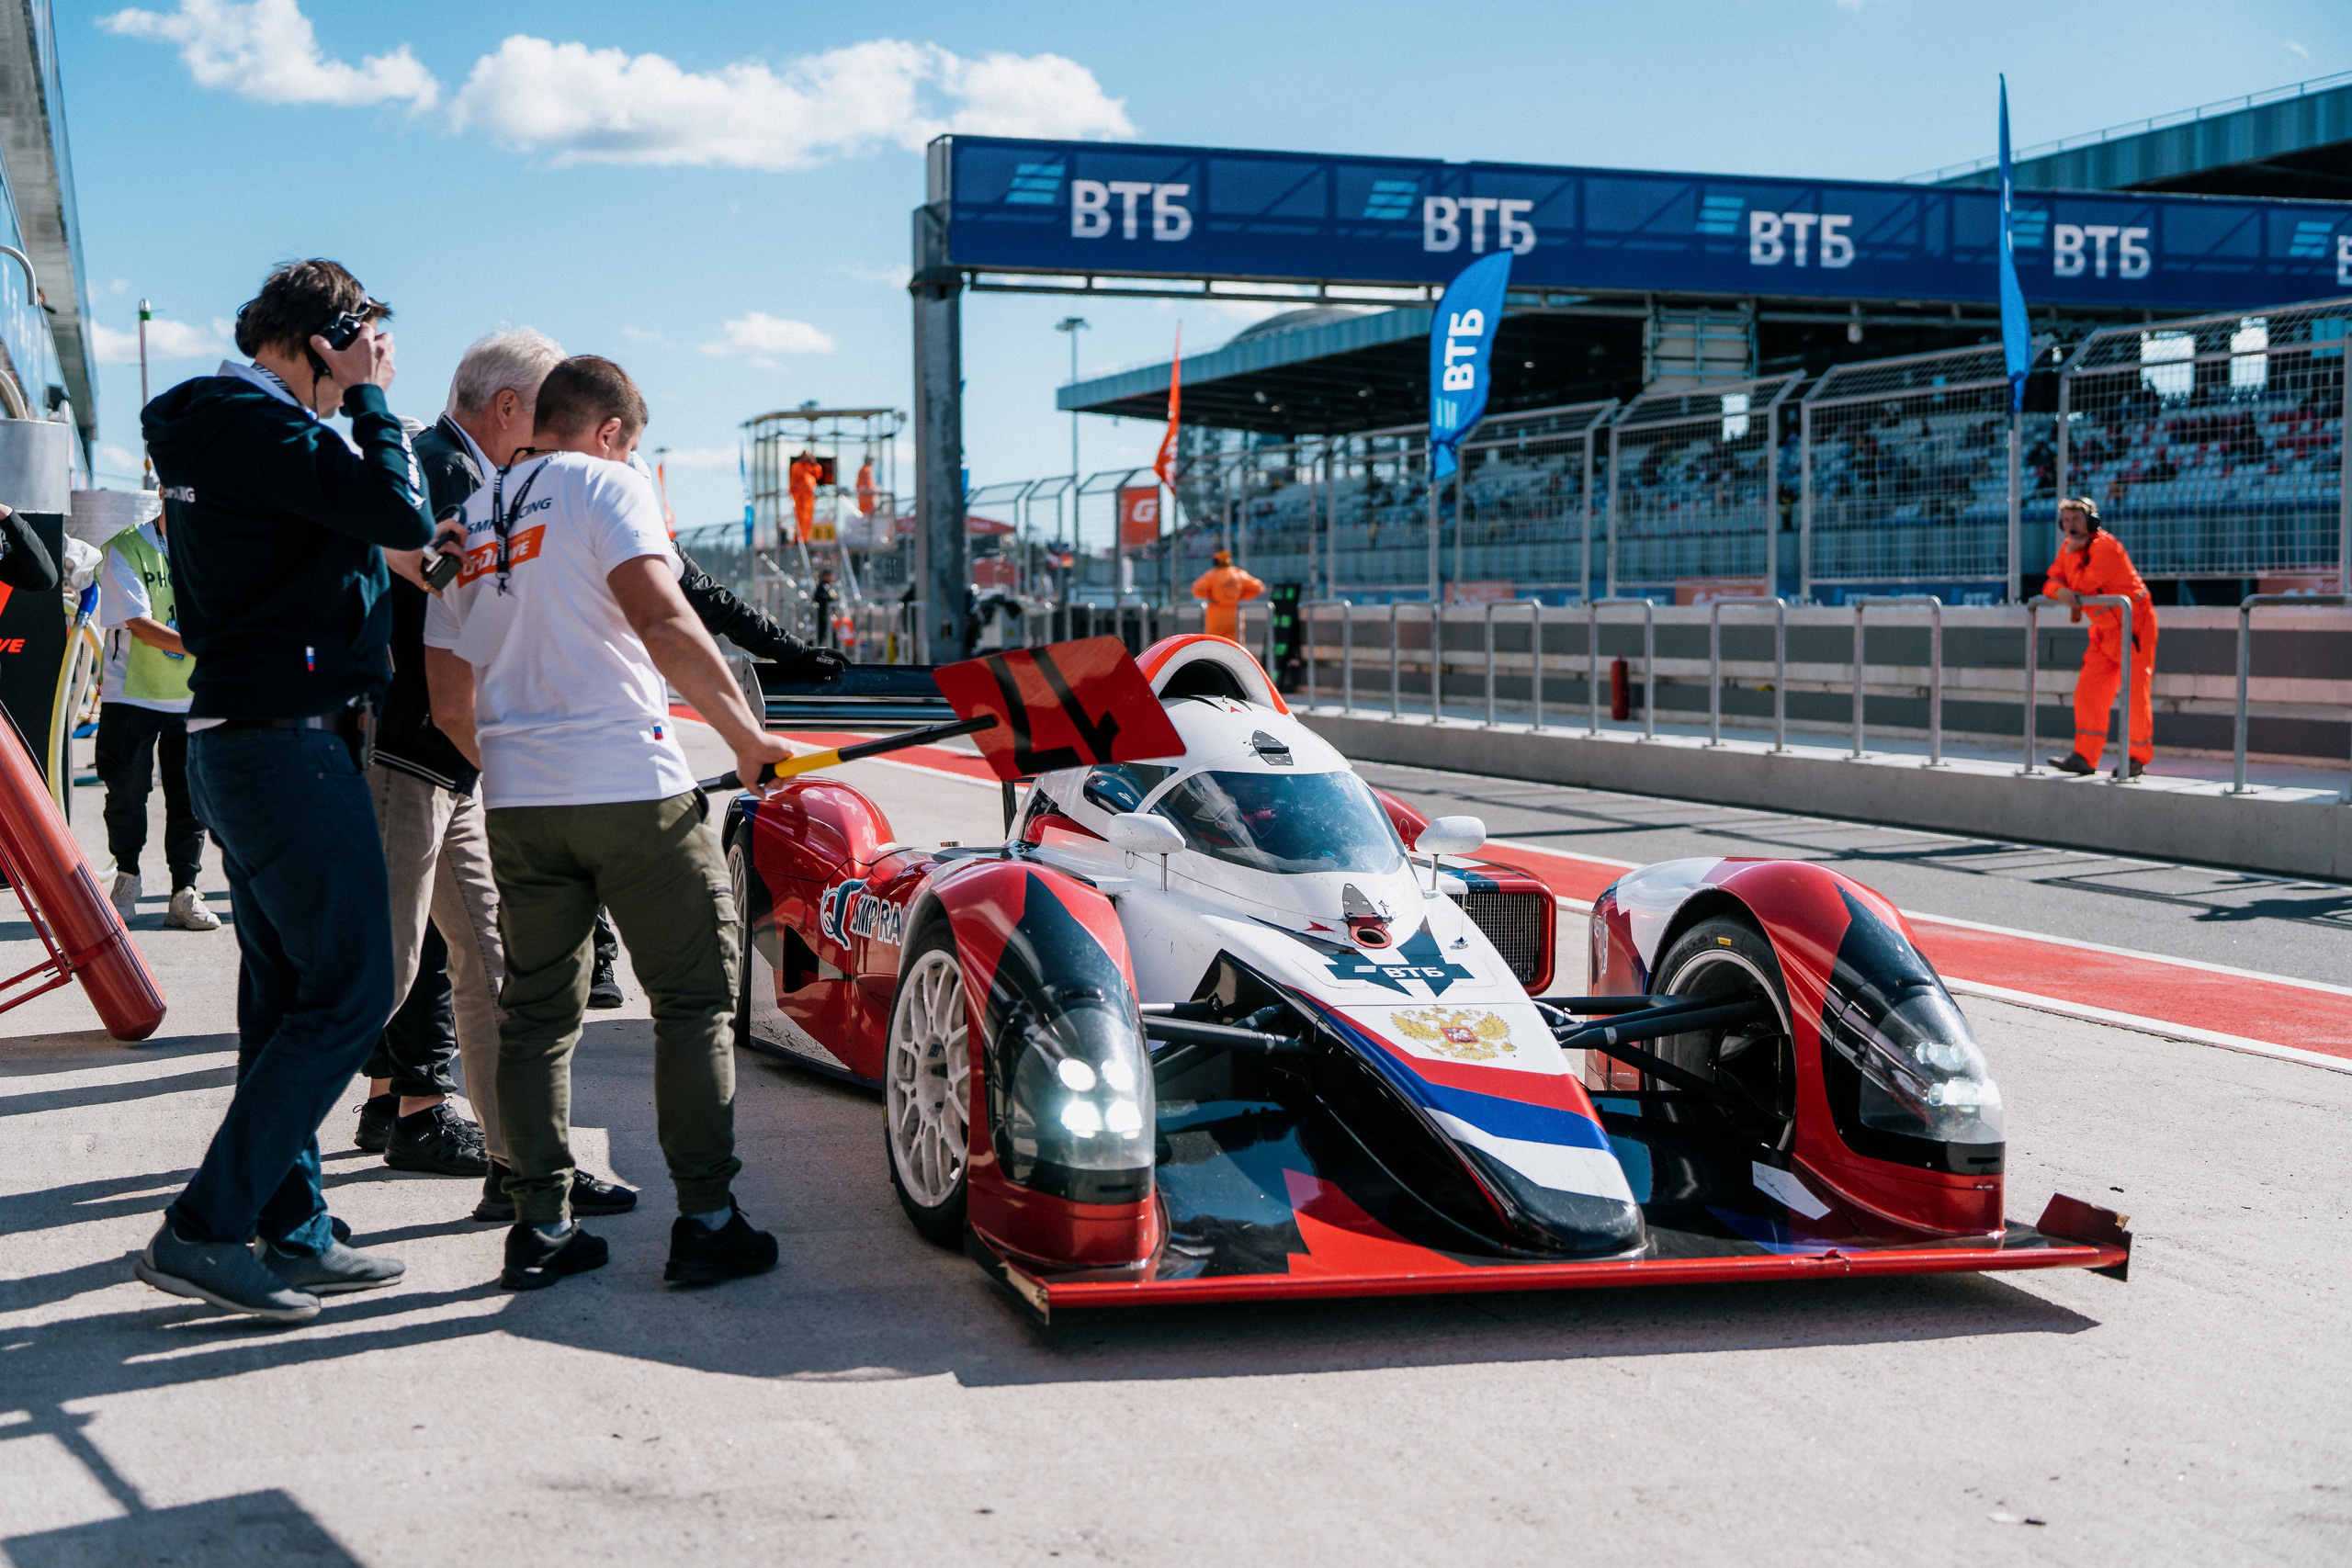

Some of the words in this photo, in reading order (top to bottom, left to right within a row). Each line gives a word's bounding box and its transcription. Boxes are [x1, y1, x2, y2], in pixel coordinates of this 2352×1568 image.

[1071, 179, 1193, 242] ВТБ
[1423, 196, 1537, 255] ВТБ
[1749, 210, 1856, 269] ВТБ
[2053, 224, 2153, 279] ВТБ
[1442, 309, 1485, 391] ВТБ
[986, 646, 1120, 775] 17
[849, 894, 879, 939] SMP
[1381, 967, 1445, 978] ВТБ
